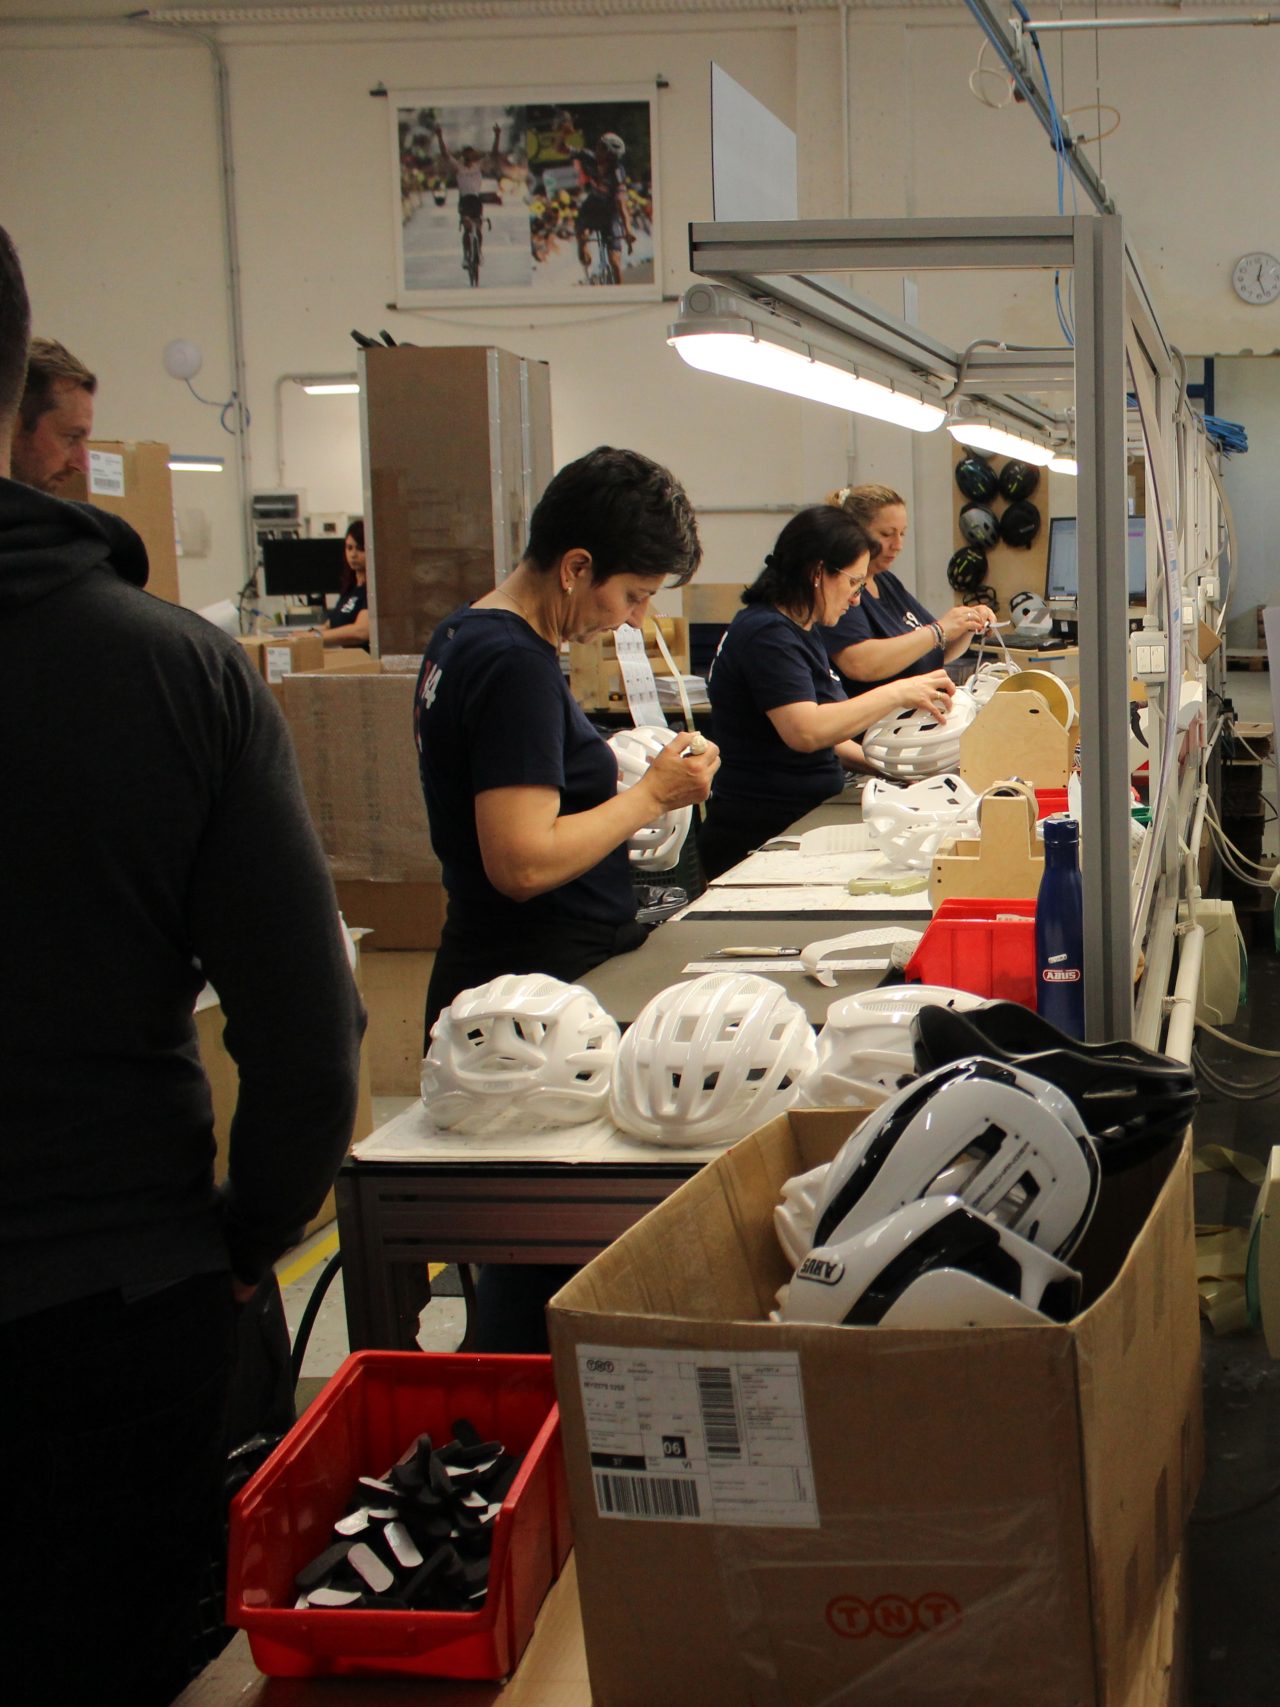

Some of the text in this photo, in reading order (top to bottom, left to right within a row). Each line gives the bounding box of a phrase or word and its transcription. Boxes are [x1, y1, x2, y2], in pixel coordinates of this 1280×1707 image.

[1046, 971, 1077, 980] ABUS
[800, 1258, 838, 1280] ABUS
[587, 1360, 613, 1372] TNT
[664, 1441, 681, 1454] 06
[826, 1597, 954, 1633] TNT
